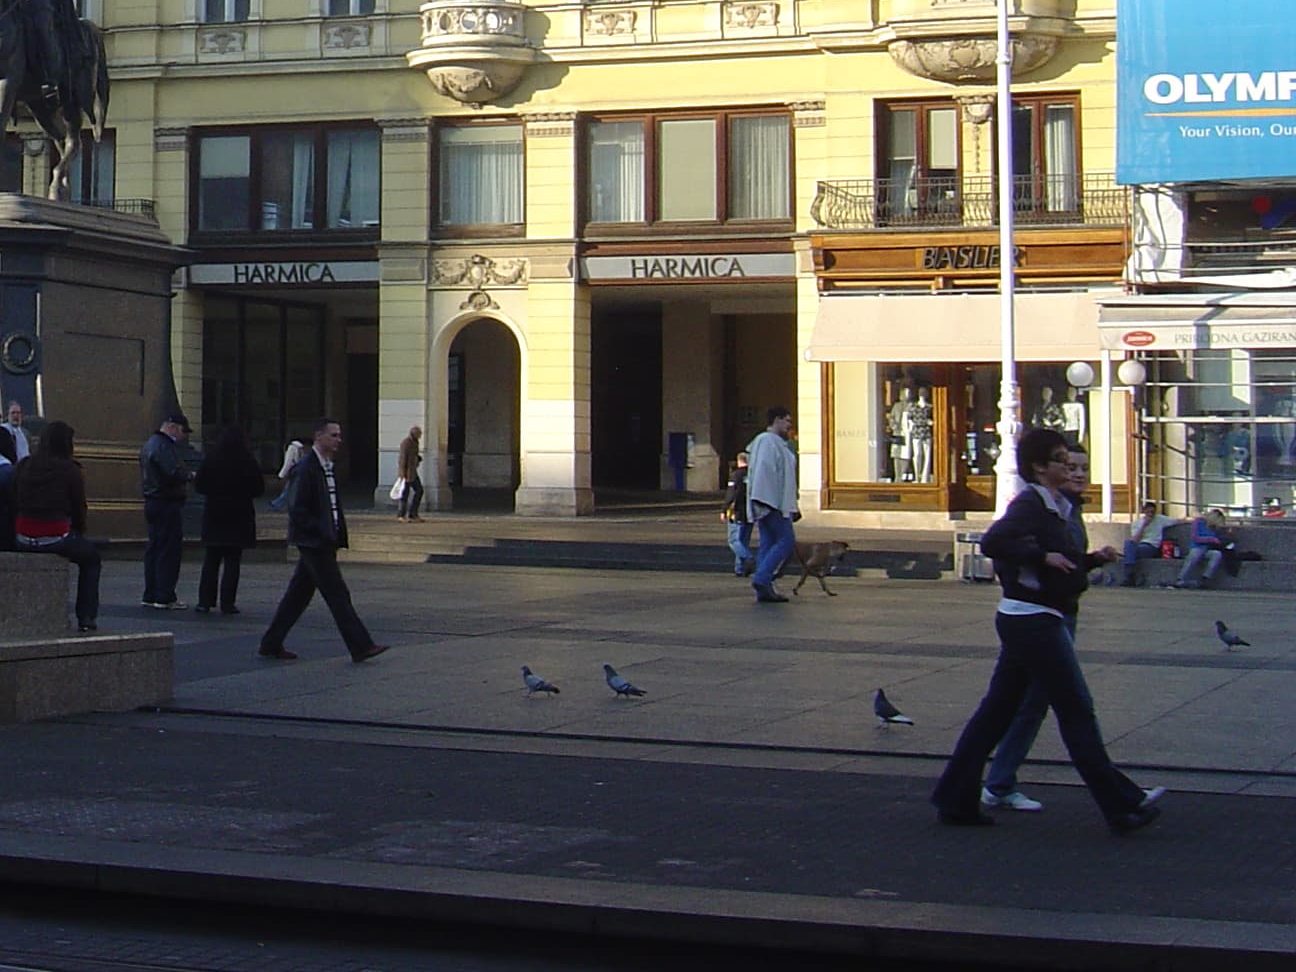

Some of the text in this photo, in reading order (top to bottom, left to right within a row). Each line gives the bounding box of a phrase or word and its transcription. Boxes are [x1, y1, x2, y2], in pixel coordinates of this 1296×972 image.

[1179, 125, 1211, 138] Your
[1215, 124, 1265, 139] Vision,
[233, 263, 336, 283] HARMICA
[630, 257, 746, 278] HARMICA
